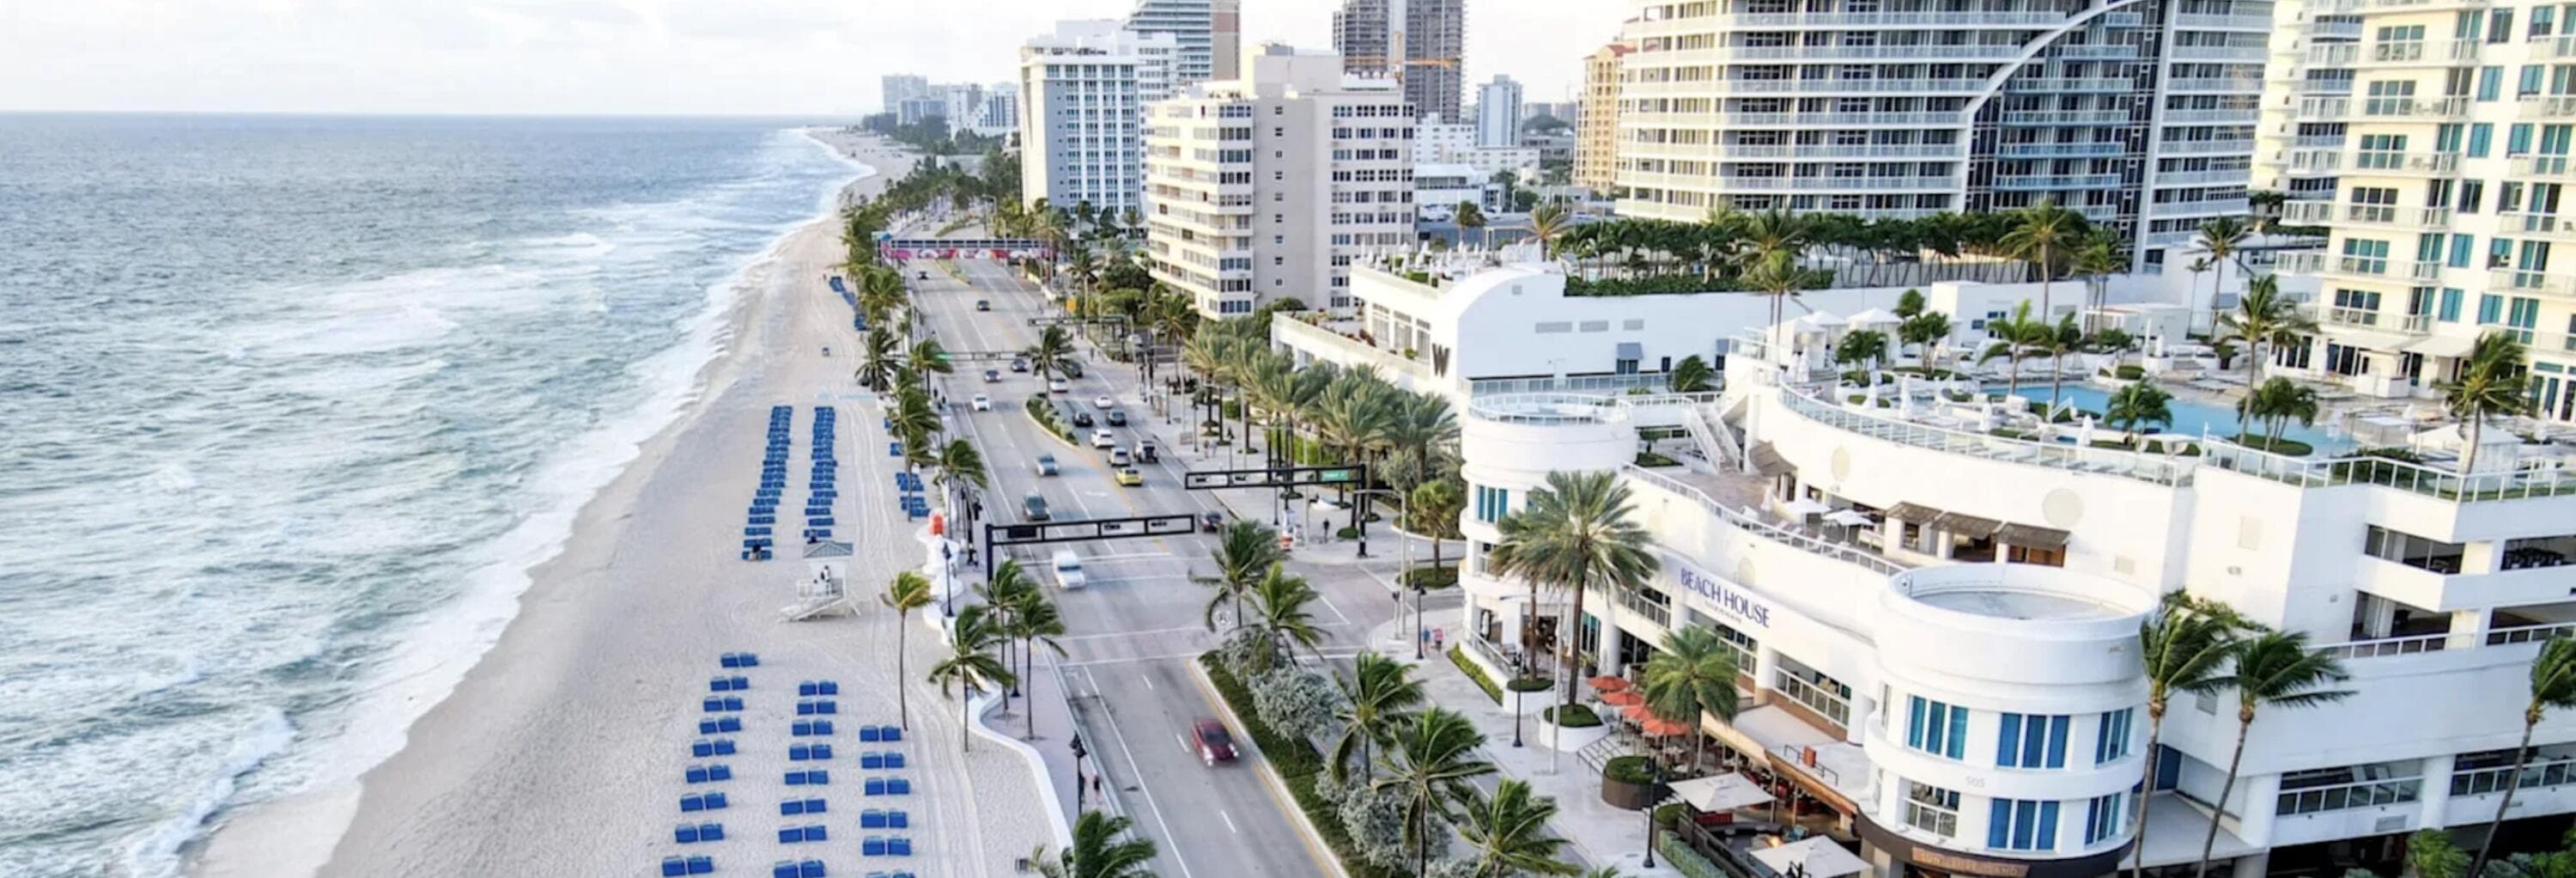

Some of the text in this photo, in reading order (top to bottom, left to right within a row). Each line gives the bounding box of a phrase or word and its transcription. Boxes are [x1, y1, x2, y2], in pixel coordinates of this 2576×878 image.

[1432, 343, 1450, 378] W
[1680, 567, 1721, 603] BEACH
[1724, 588, 1770, 629] HOUSE
